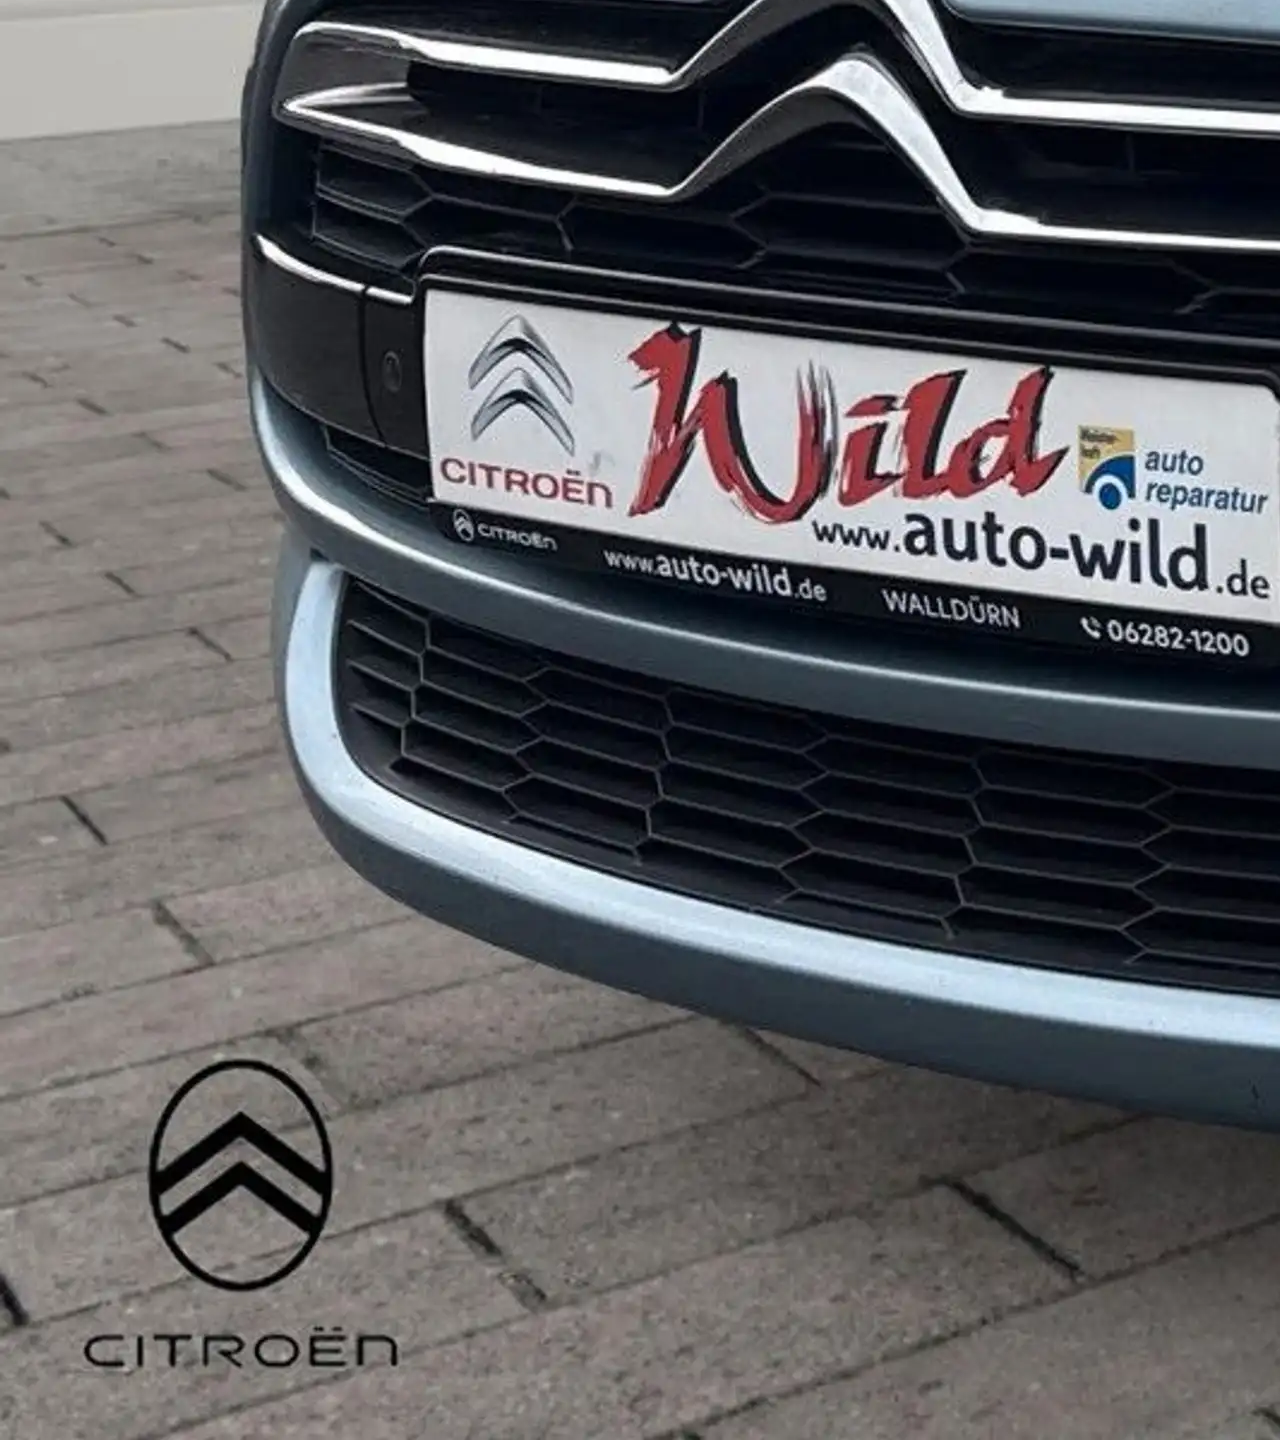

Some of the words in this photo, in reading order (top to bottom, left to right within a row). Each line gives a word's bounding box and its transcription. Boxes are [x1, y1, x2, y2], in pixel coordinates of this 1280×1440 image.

[627, 321, 1070, 525] Wild
[1145, 449, 1205, 476] auto
[1145, 481, 1269, 515] reparatur
[603, 549, 828, 602] www.auto-wild.de
[811, 511, 1271, 600] www.auto-wild.de
[881, 587, 1021, 629] WALLDÜRN
[1106, 619, 1250, 658] 06282-1200
